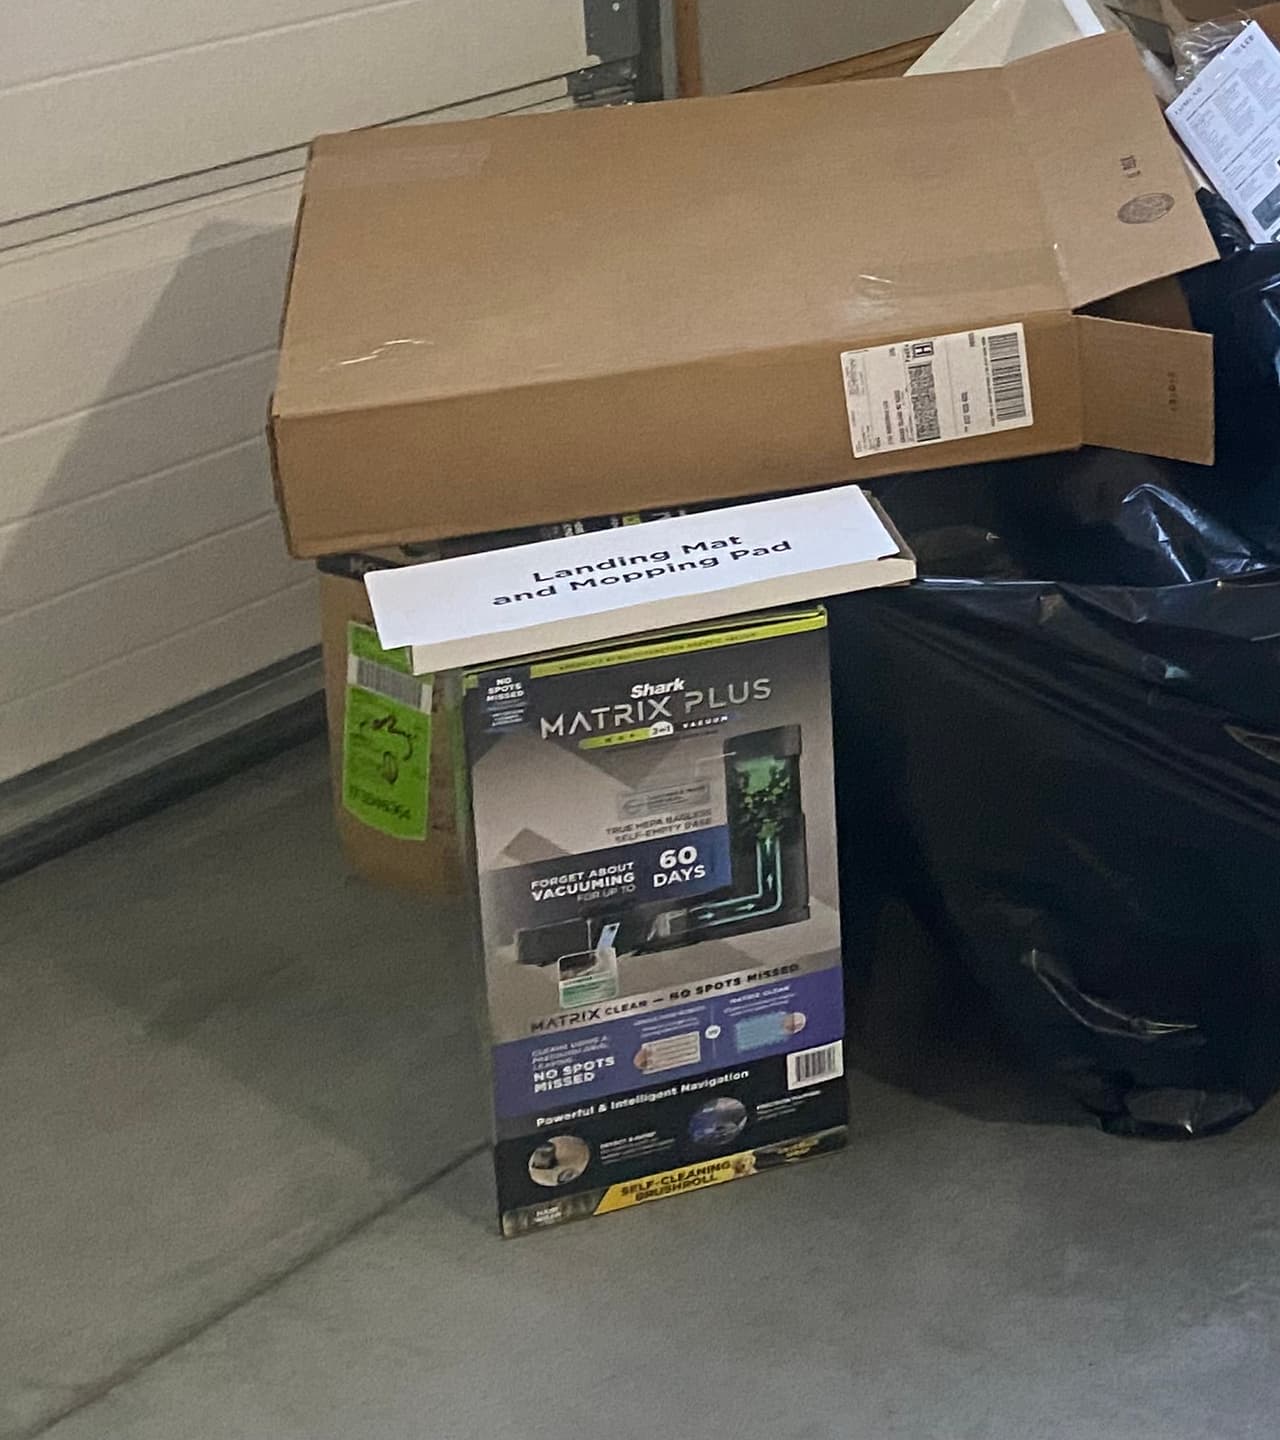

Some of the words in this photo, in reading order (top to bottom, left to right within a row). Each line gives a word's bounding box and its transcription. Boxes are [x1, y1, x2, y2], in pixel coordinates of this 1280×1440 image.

[532, 548, 670, 583] Landing
[682, 535, 743, 555] Mat
[492, 585, 557, 606] and
[569, 556, 720, 591] Mopping
[731, 540, 793, 560] Pad
[487, 682, 523, 695] SPOTS
[496, 677, 512, 686] NO
[630, 677, 686, 699] Shark
[486, 690, 525, 702] MISSED
[540, 696, 673, 740] MATRIX
[684, 678, 772, 713] PLUS
[606, 823, 634, 836] TRUE
[659, 846, 698, 869] 60
[530, 871, 585, 890] FORGET
[589, 862, 634, 878] ABOUT
[531, 872, 635, 902] VACUUMING
[653, 865, 706, 888] DAYS
[576, 891, 601, 902] FOR
[602, 887, 618, 898] UP
[621, 884, 636, 895] TO
[530, 1008, 601, 1033] MATRIX
[669, 988, 692, 1002] NO
[696, 977, 741, 995] SPOTS
[533, 1067, 559, 1082] NO
[562, 1056, 616, 1076] SPOTS
[534, 1072, 595, 1094] MISSED
[536, 1108, 594, 1128] Powerful
[610, 1086, 678, 1112] Intelligent
[680, 1070, 750, 1094] Navigation
[620, 1160, 732, 1197] SELF-CLEANING
[635, 1174, 719, 1201] BRUSHROLL
